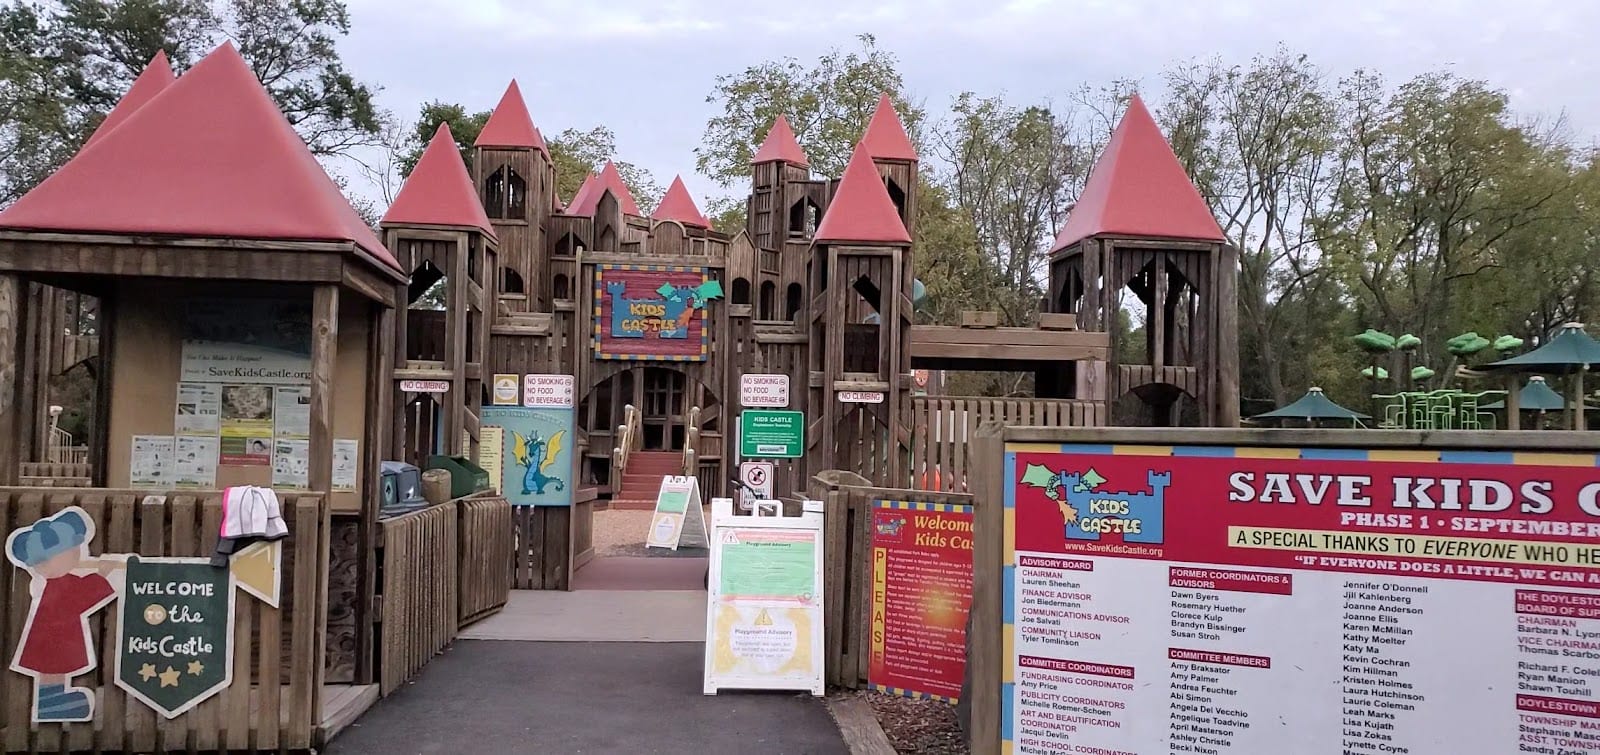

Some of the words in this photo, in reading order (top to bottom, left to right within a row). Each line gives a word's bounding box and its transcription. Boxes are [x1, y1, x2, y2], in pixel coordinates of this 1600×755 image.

[630, 304, 666, 316] KIDS
[622, 319, 676, 332] CASTLE
[209, 366, 312, 379] SaveKidsCastle.org
[1228, 471, 1372, 506] SAVE
[1392, 477, 1554, 516] KIDS
[1090, 499, 1130, 514] KIDS
[1080, 518, 1142, 534] CASTLE
[1340, 512, 1413, 529] PHASE
[1419, 517, 1431, 529] 1
[1451, 517, 1600, 538] SEPTEMBER
[915, 532, 946, 547] Kids
[1237, 530, 1247, 544] A
[1252, 530, 1318, 549] SPECIAL
[1322, 534, 1389, 552] THANKS
[1395, 538, 1416, 553] TO
[1423, 540, 1518, 560] EVERYONE
[1523, 545, 1568, 562] WHO
[1065, 542, 1163, 558] www.SaveKidsCastle.org
[1022, 558, 1060, 568] ADVISORY
[1062, 560, 1091, 570] BOARD
[1320, 557, 1398, 571] EVERYONE
[1400, 561, 1440, 573] DOES
[1443, 563, 1456, 574] A
[1519, 569, 1546, 581] WE
[1549, 571, 1586, 583] CAN
[1022, 569, 1063, 579] CHAIRMAN
[1172, 567, 1208, 579] FORMER
[1210, 570, 1280, 584] COORDINATORS
[132, 582, 214, 597] WELCOME
[1022, 578, 1047, 586] Lauren
[1049, 579, 1080, 589] Sheehan
[1172, 578, 1215, 589] ADVISORS
[1343, 581, 1380, 591] Jennifer
[1383, 582, 1428, 593] O'Donnell
[1022, 588, 1055, 598] FINANCE
[1057, 591, 1091, 601] ADVISOR
[1172, 590, 1194, 600] Dawn
[1196, 592, 1219, 602] Byers
[1518, 593, 1538, 601] THE
[1542, 594, 1600, 606] DOYLESTO
[1172, 600, 1211, 612] Rosemary
[1214, 604, 1246, 614] Huether
[1517, 604, 1557, 613] BOARD
[169, 605, 204, 623] the
[1022, 607, 1092, 620] COMMUNICATIONS
[1094, 613, 1130, 624] ADVISOR
[1343, 613, 1376, 622] Joanne
[1379, 615, 1398, 623] Ellis
[1518, 616, 1576, 627] CHAIRMAN
[1022, 625, 1067, 638] COMMUNITY
[1070, 630, 1101, 640] LIAISON
[1171, 630, 1196, 639] Susan
[1198, 631, 1220, 641] Stroh
[1343, 623, 1371, 633] Karen
[1372, 625, 1413, 635] McMillan
[1518, 625, 1558, 635] Barbara
[1518, 636, 1543, 645] VICE
[1546, 639, 1600, 650] CHAIRMA
[1171, 649, 1221, 663] COMMITTEE
[1223, 654, 1268, 667] MEMBERS
[1518, 645, 1559, 655] Thomas
[1563, 649, 1600, 659] Scarbo
[1021, 656, 1066, 670] COMMITTEE
[1068, 662, 1132, 677] COORDINATORS
[1343, 665, 1361, 674] Kim
[1363, 667, 1397, 677] Hillman
[1518, 662, 1558, 672] Richard
[1022, 671, 1073, 684] FUNDRAISING
[1075, 677, 1134, 691] COORDINATOR
[1171, 671, 1189, 682] Amy
[1191, 673, 1219, 684] Palmer
[1343, 676, 1376, 687] Kristen
[1378, 679, 1413, 689] Holmes
[1518, 672, 1544, 681] Ryan
[1548, 675, 1586, 685] Manion
[1022, 680, 1038, 690] Amy
[1040, 681, 1058, 690] Price
[1518, 682, 1552, 692] Shawn
[1556, 686, 1591, 696] Touhill
[1021, 689, 1061, 700] PUBLICITY
[1062, 695, 1125, 709] COORDINATORS
[1343, 686, 1368, 695] Laura
[1371, 689, 1425, 701] Hutchinson
[1170, 703, 1198, 711] Angela
[1216, 708, 1248, 717] Vecchio
[1343, 697, 1371, 706] Laurie
[1374, 700, 1415, 711] Coleman
[1519, 698, 1596, 713] DOYLESTOWN
[1056, 713, 1120, 728] BEAUTIFICATION
[1170, 713, 1210, 723] Angelique
[1213, 717, 1250, 728] Toadvine
[1343, 708, 1365, 716] Leah
[1368, 710, 1395, 720] Marks
[1519, 714, 1576, 727] TOWNSHIP
[1021, 719, 1076, 732] COORDINATOR
[1170, 723, 1189, 731] April
[1192, 725, 1233, 736] Masterson
[1343, 718, 1362, 726] Lisa
[1364, 720, 1394, 730] Kujath
[1520, 725, 1570, 737] Stephanie
[1021, 738, 1039, 746] HIGH
[1041, 740, 1073, 751] SCHOOL
[1170, 733, 1197, 742] Ashley
[1200, 736, 1231, 747] Christie
[1552, 738, 1600, 750] TOWNSH
[1170, 743, 1192, 751] Becki
[1195, 745, 1217, 755] Nixon
[1520, 744, 1554, 754] Sandra
